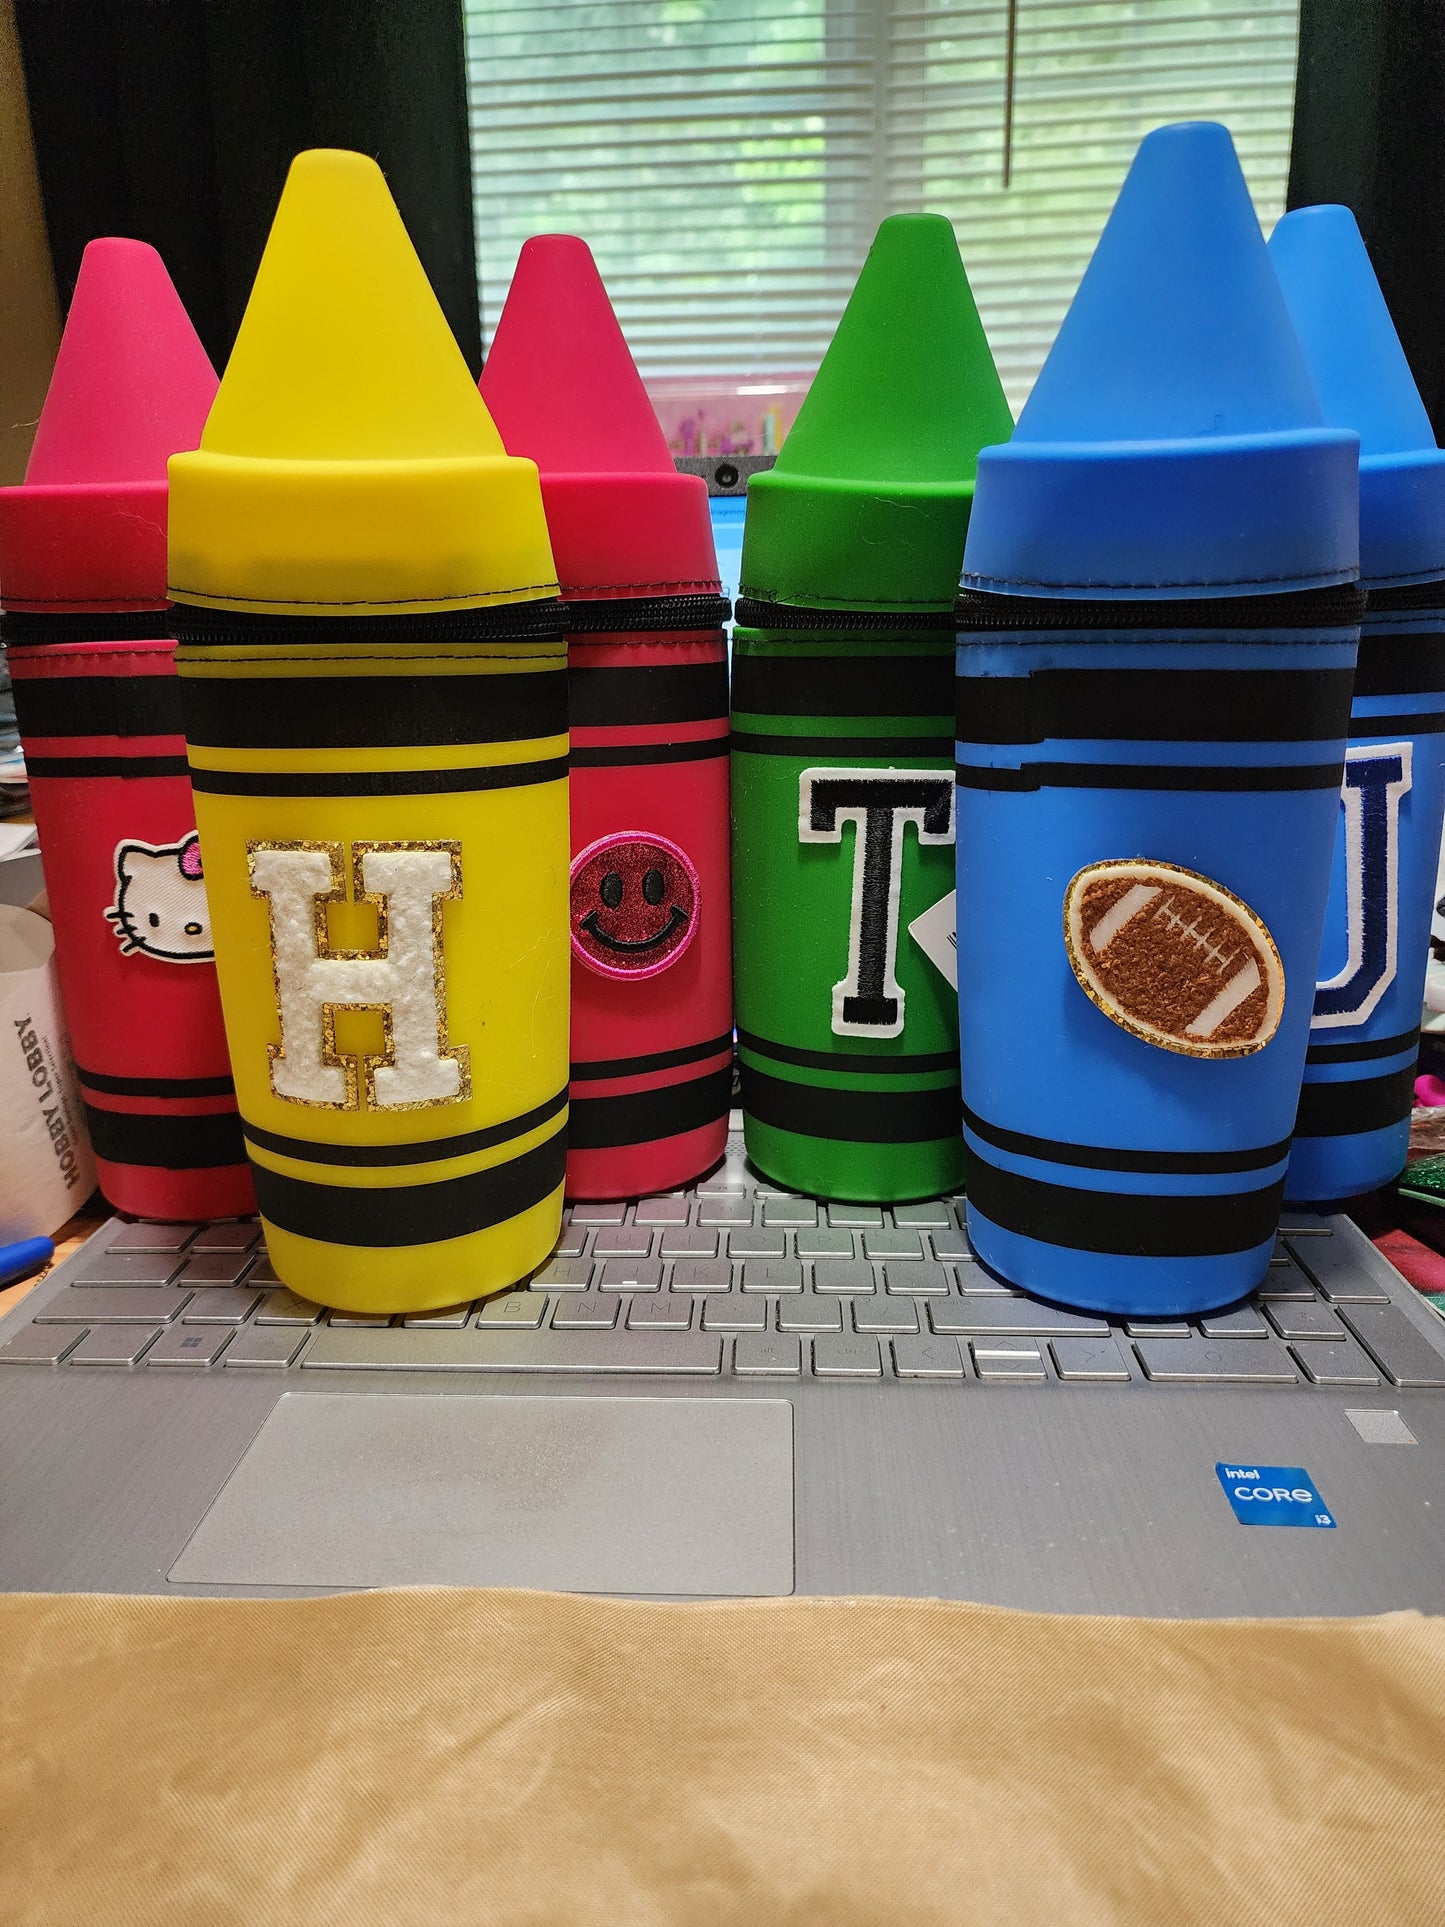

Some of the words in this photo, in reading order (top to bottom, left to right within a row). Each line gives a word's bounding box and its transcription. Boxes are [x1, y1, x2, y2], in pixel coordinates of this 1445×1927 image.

[799, 767, 956, 1039] T
[246, 838, 473, 1113] H
[14, 1016, 54, 1104] LOBBY
[43, 1104, 81, 1190] HOBBY
[552, 1265, 573, 1278] H
[503, 1300, 523, 1314] B
[577, 1300, 598, 1314] N
[650, 1301, 672, 1315] M
[1224, 1467, 1261, 1480] intel
[1314, 1514, 1332, 1526] i3
